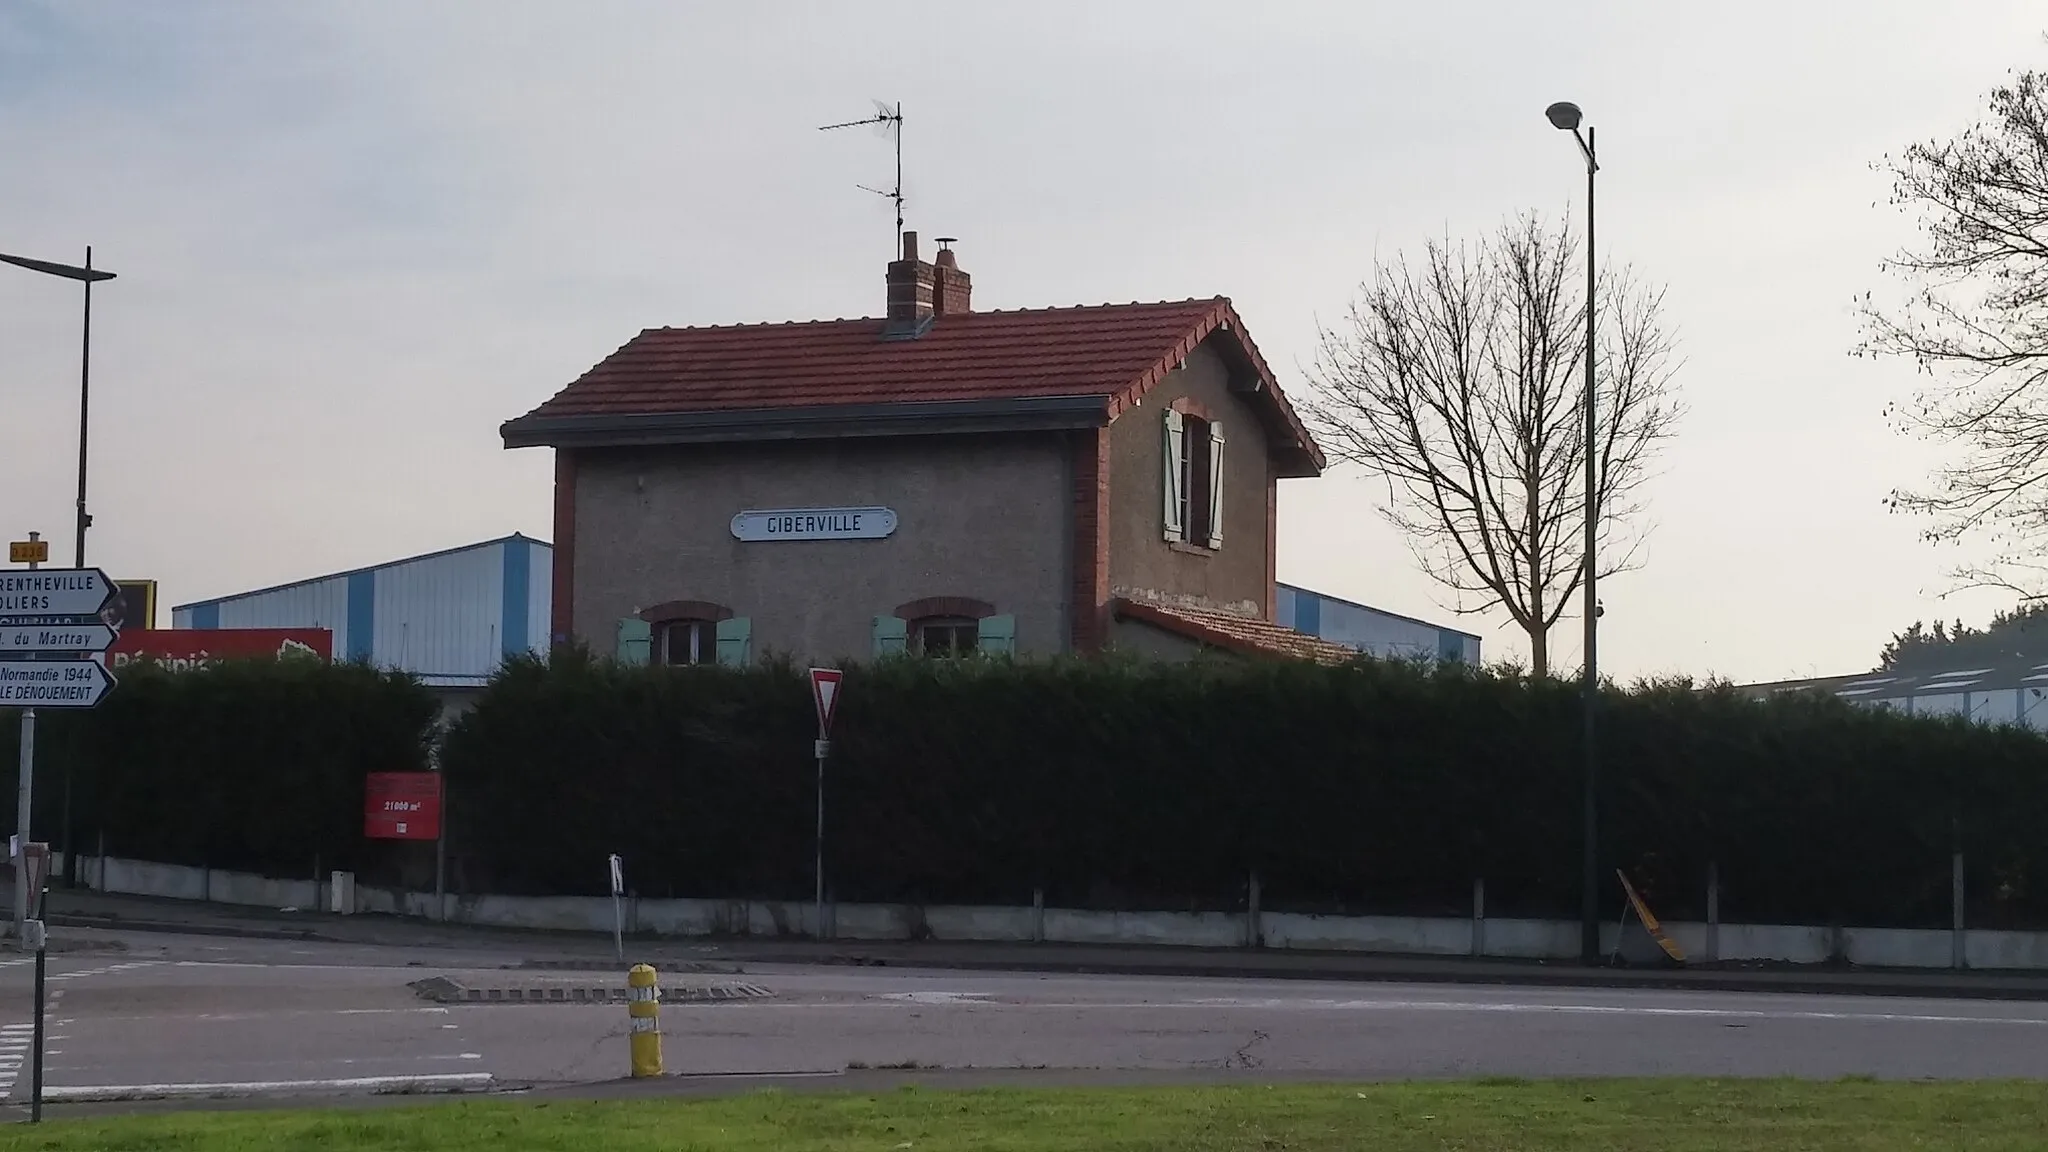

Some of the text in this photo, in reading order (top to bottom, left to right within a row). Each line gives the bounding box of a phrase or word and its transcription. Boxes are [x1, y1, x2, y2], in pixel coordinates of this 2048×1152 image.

[767, 515, 862, 532] GIBERVILLE
[14, 632, 29, 645] du
[38, 632, 91, 647] Martray
[0, 667, 92, 681] Normandie 1944
[15, 683, 92, 699] DÉNOUEMENT
